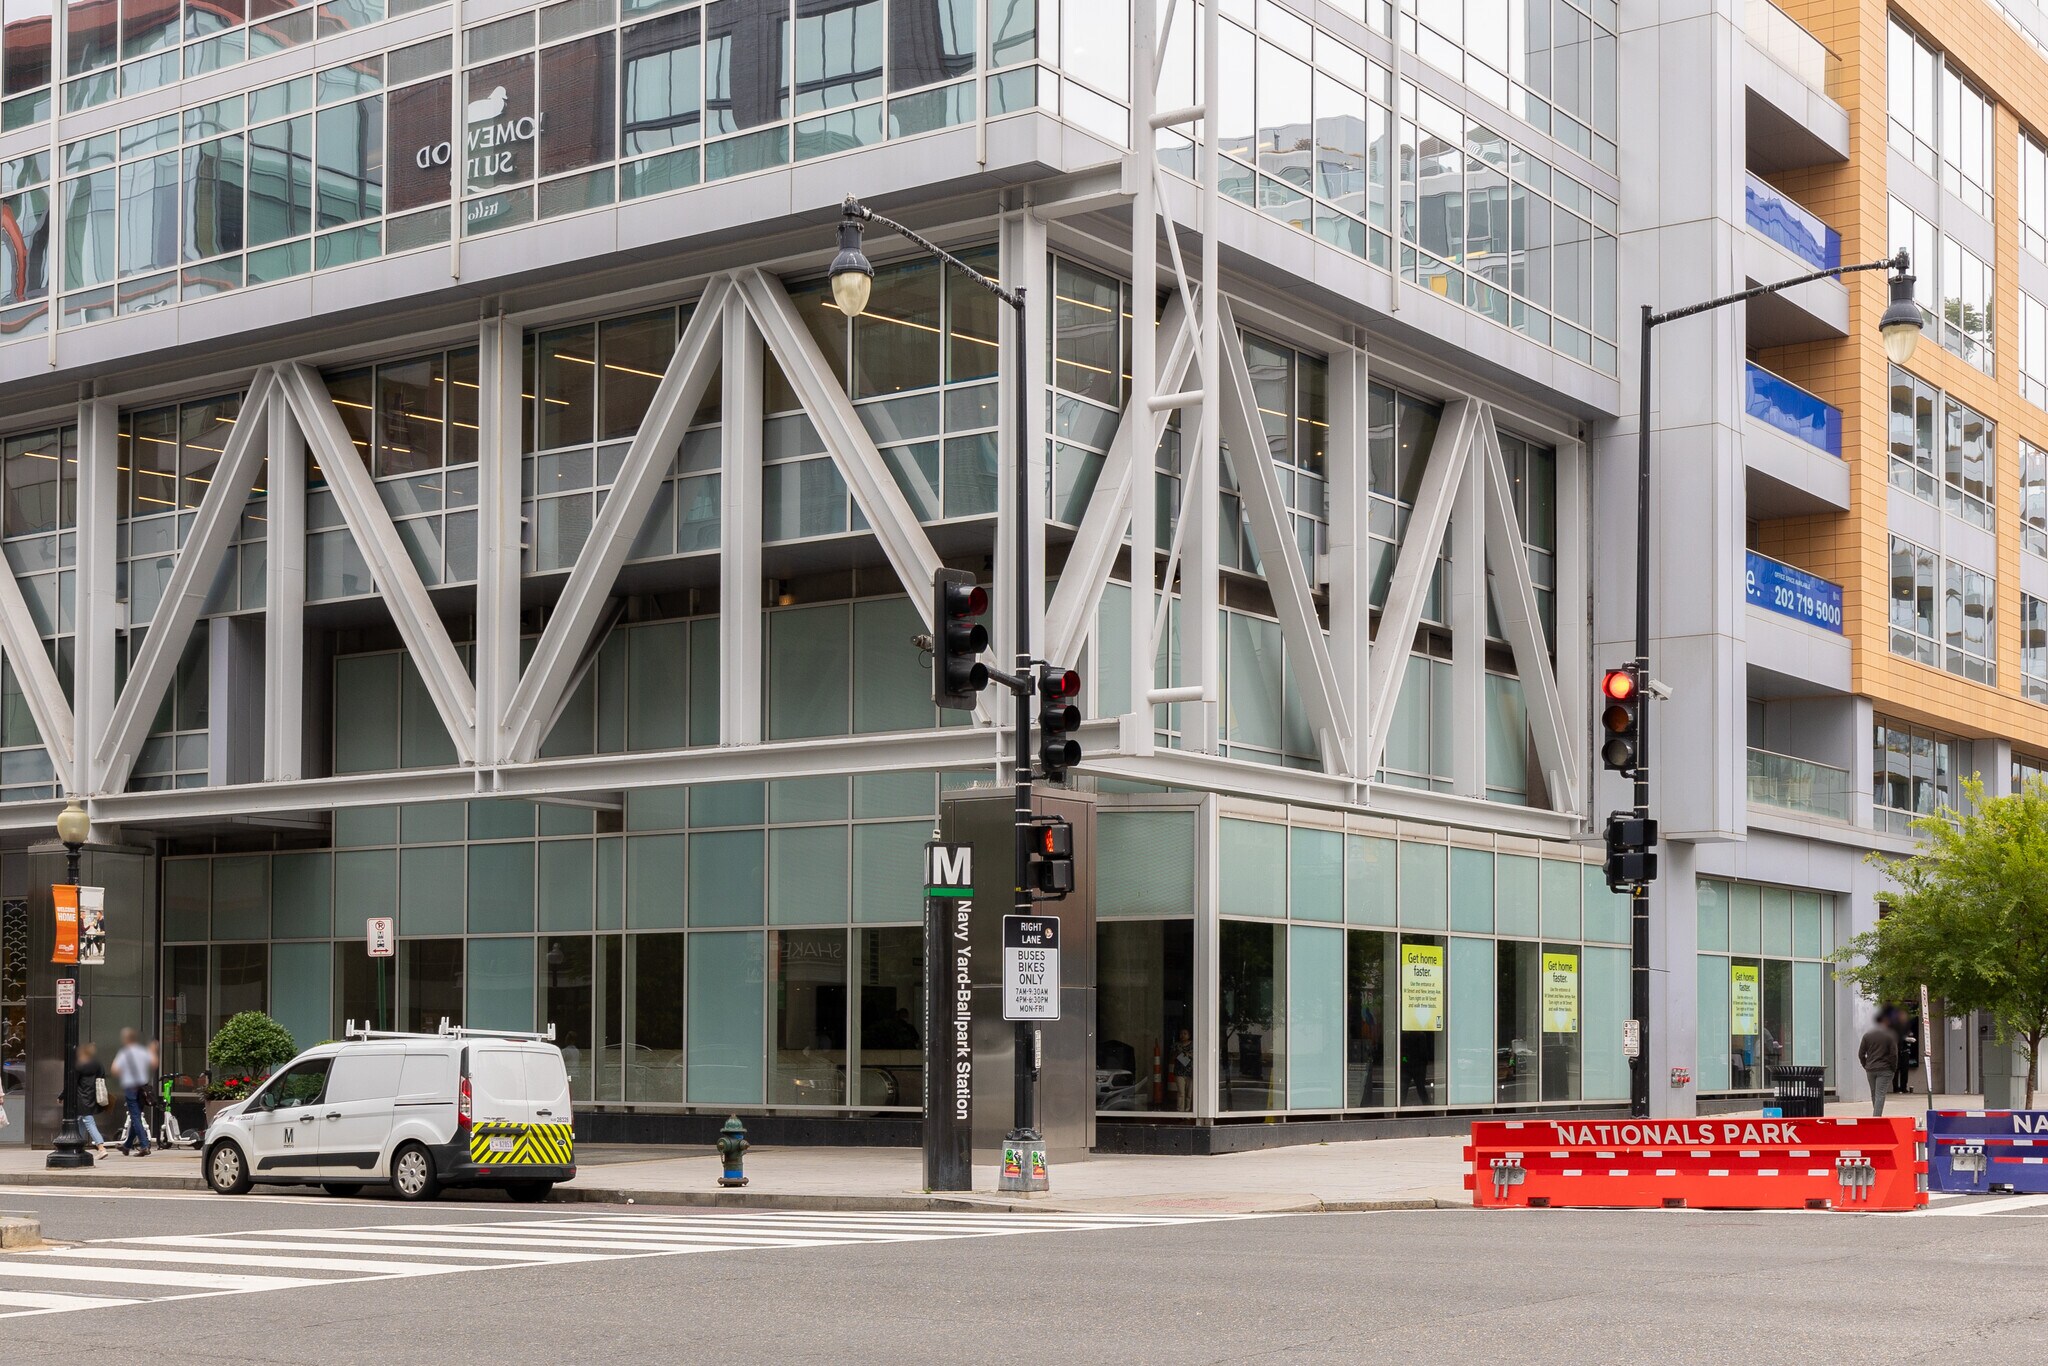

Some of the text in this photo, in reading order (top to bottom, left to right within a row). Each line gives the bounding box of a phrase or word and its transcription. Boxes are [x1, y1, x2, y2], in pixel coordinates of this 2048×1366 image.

[1774, 571, 1811, 590] OFFICE SPACE AVAILABLE
[1775, 585, 1841, 626] 202 719 5000
[933, 846, 971, 885] M
[58, 913, 76, 922] HOME
[1021, 923, 1042, 932] RIGHT
[1022, 935, 1042, 944] LANE
[1018, 951, 1045, 961] BUSES
[1408, 953, 1437, 965] Get home
[1019, 963, 1045, 972] BIKES
[1414, 965, 1431, 977] faster.
[1548, 961, 1573, 972] Get home
[1019, 974, 1044, 985] ONLY
[1553, 972, 1568, 983] faster.
[1744, 972, 1755, 982] home
[954, 900, 972, 1120] Navy Yard-Ballpark Station
[1020, 1005, 1045, 1013] MON-FRI
[2013, 1114, 2048, 1134] NA
[284, 1128, 294, 1143] M
[1557, 1123, 1802, 1145] NATIONALS PARK
